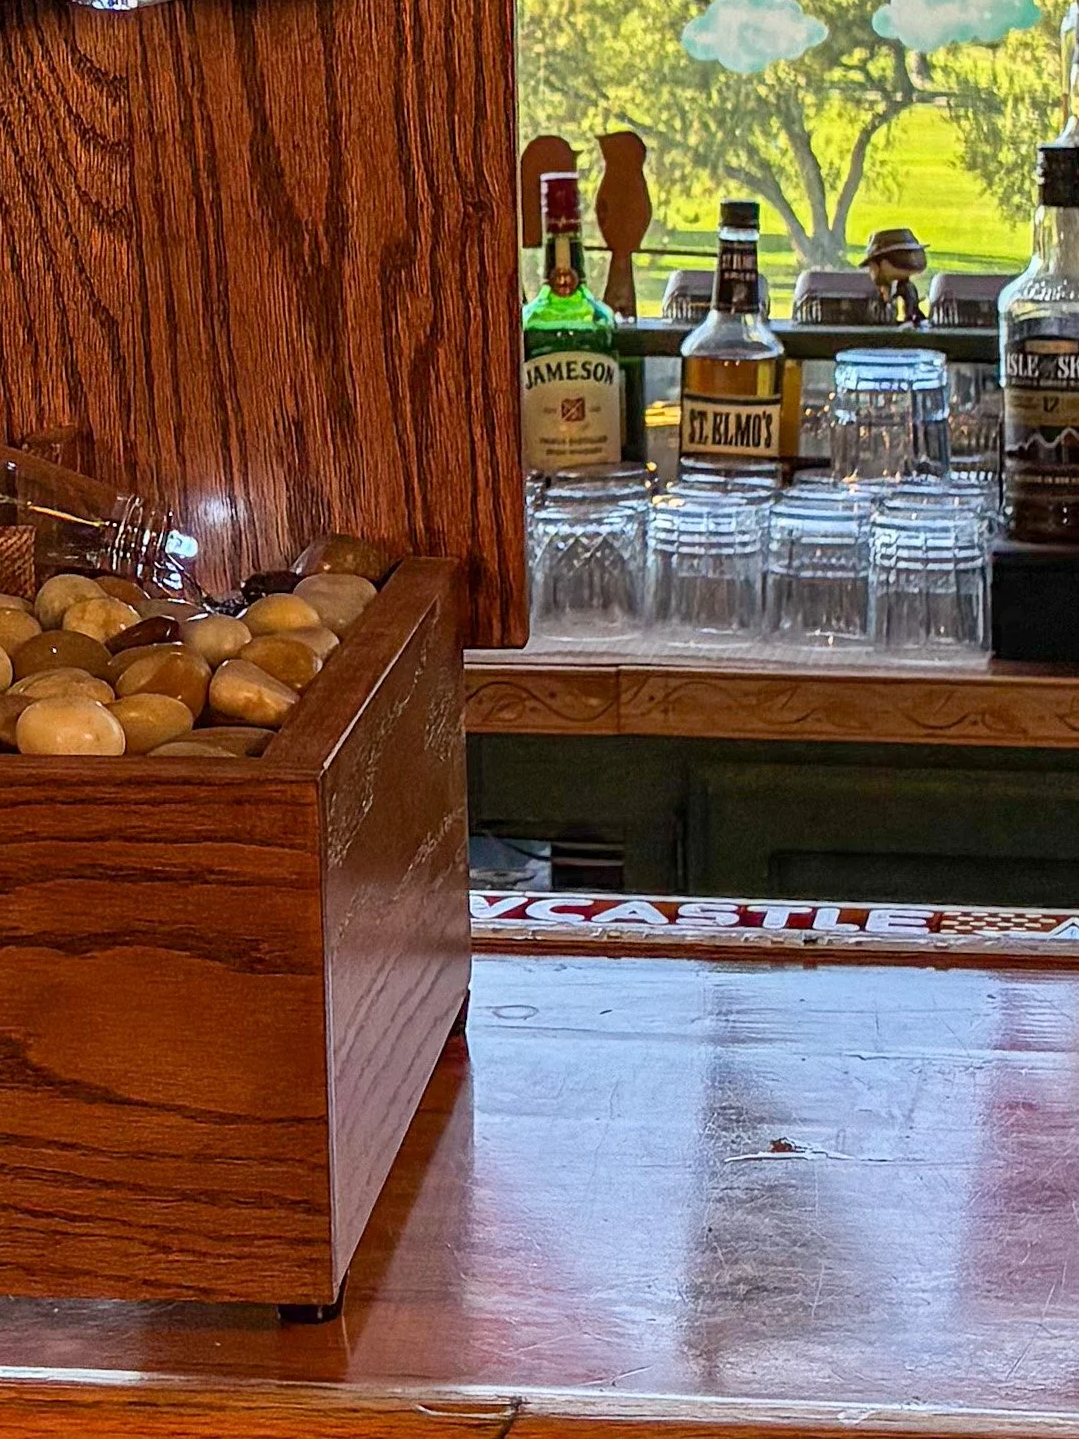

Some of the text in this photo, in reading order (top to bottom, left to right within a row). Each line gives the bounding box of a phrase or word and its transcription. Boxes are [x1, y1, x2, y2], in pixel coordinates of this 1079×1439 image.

[525, 361, 614, 390] JAMESON
[1006, 352, 1040, 379] ISLE
[690, 409, 773, 449] ST. ELMO'S
